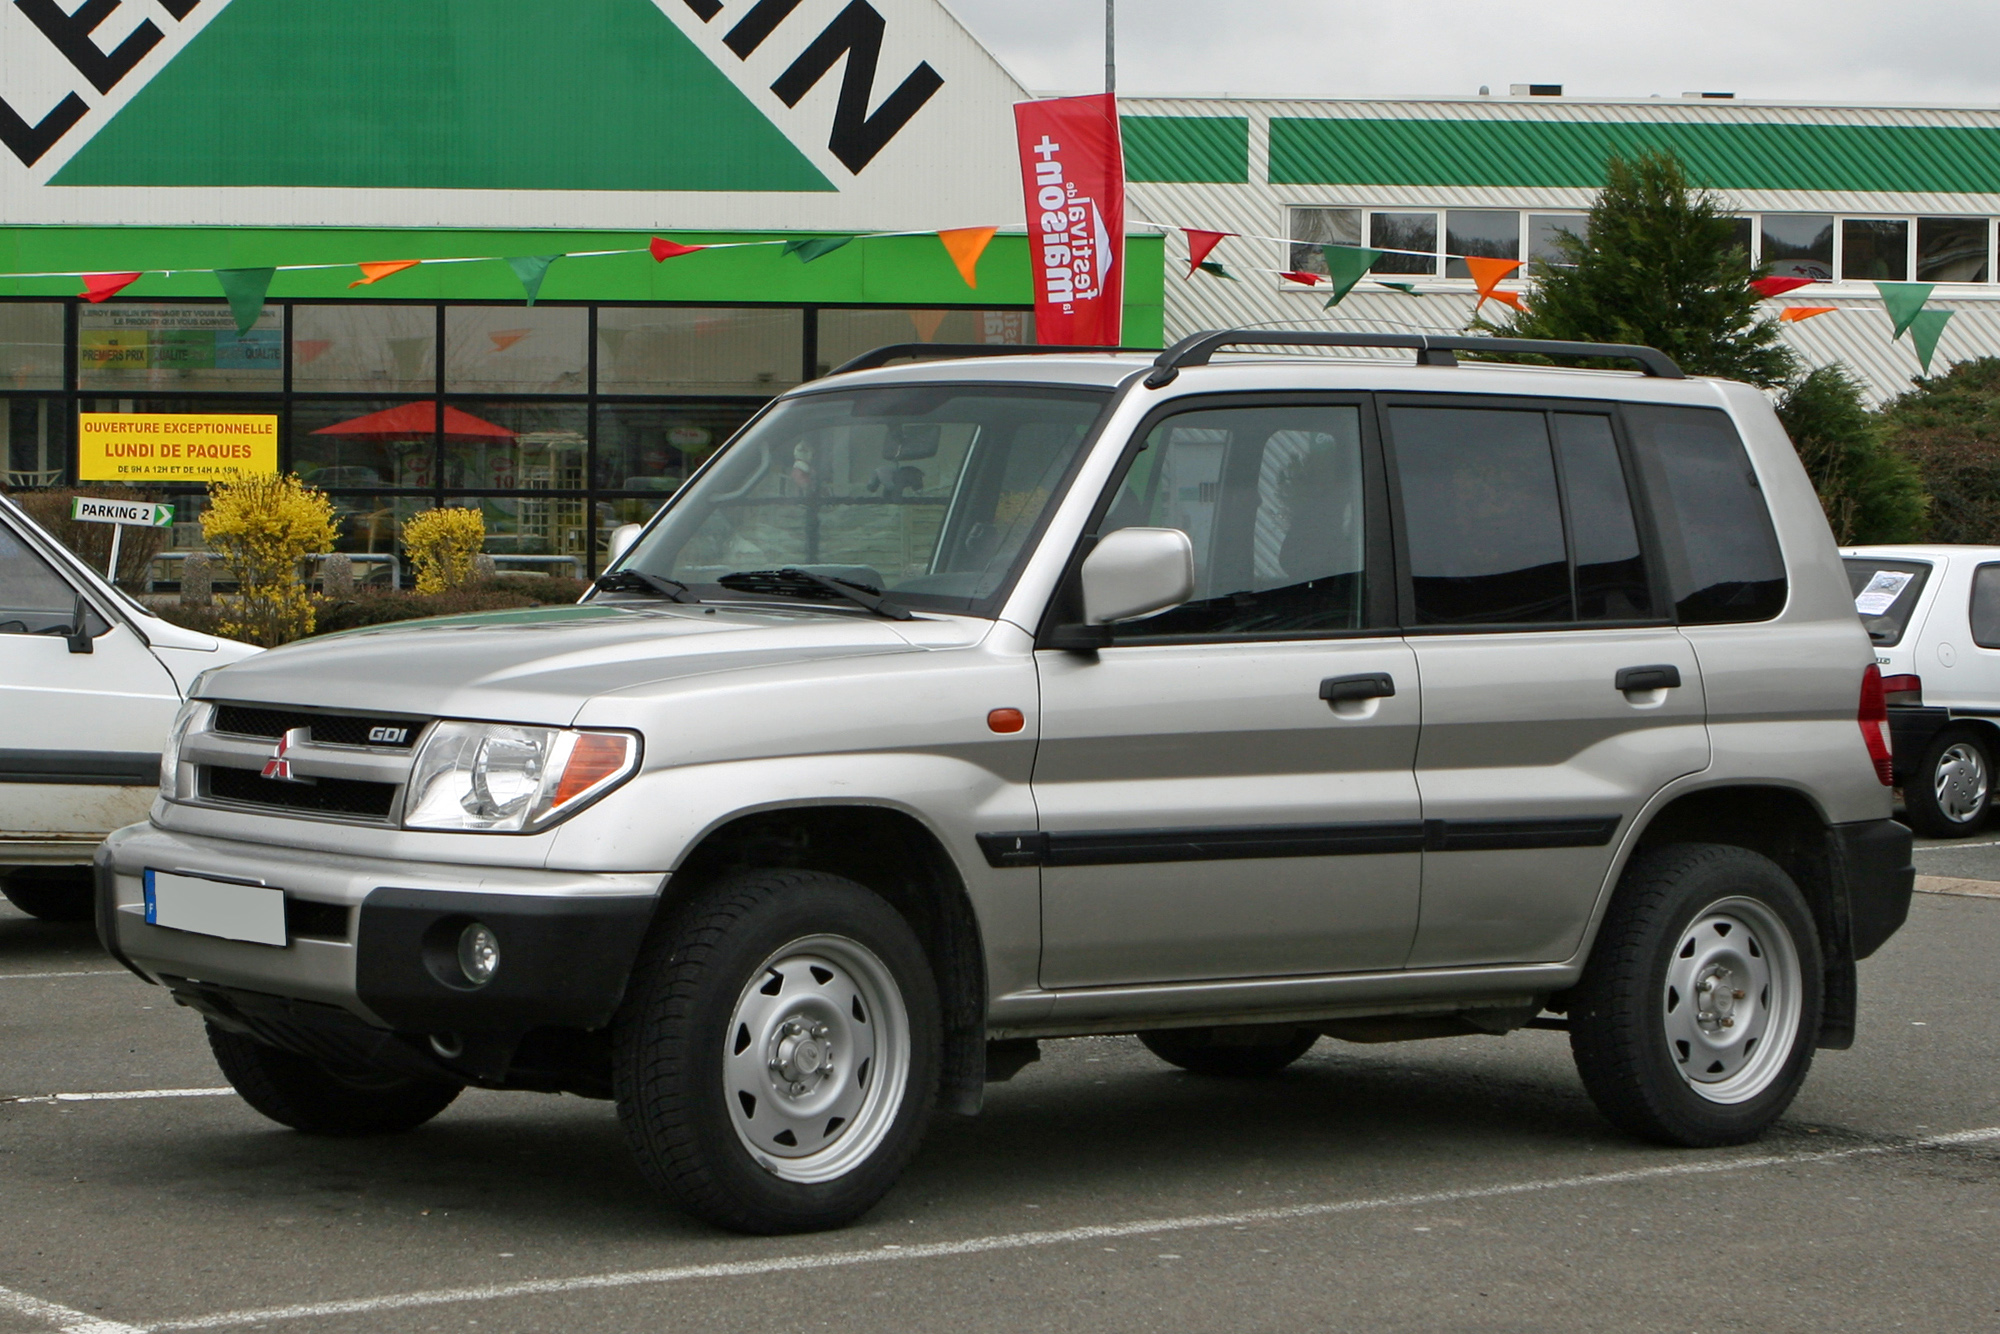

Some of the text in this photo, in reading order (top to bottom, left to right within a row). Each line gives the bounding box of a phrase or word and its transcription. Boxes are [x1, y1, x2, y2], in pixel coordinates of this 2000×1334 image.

[0, 0, 200, 168] LE
[684, 0, 945, 176] IN
[125, 349, 145, 361] PRIX
[84, 422, 273, 434] OUVERTURE EXCEPTIONNELLE
[105, 443, 252, 459] LUNDI DE PAQUES
[118, 465, 129, 473] DE
[131, 465, 142, 473] 9H
[197, 466, 212, 474] 14H
[81, 503, 150, 520] PARKING 2
[368, 726, 408, 743] GDI
